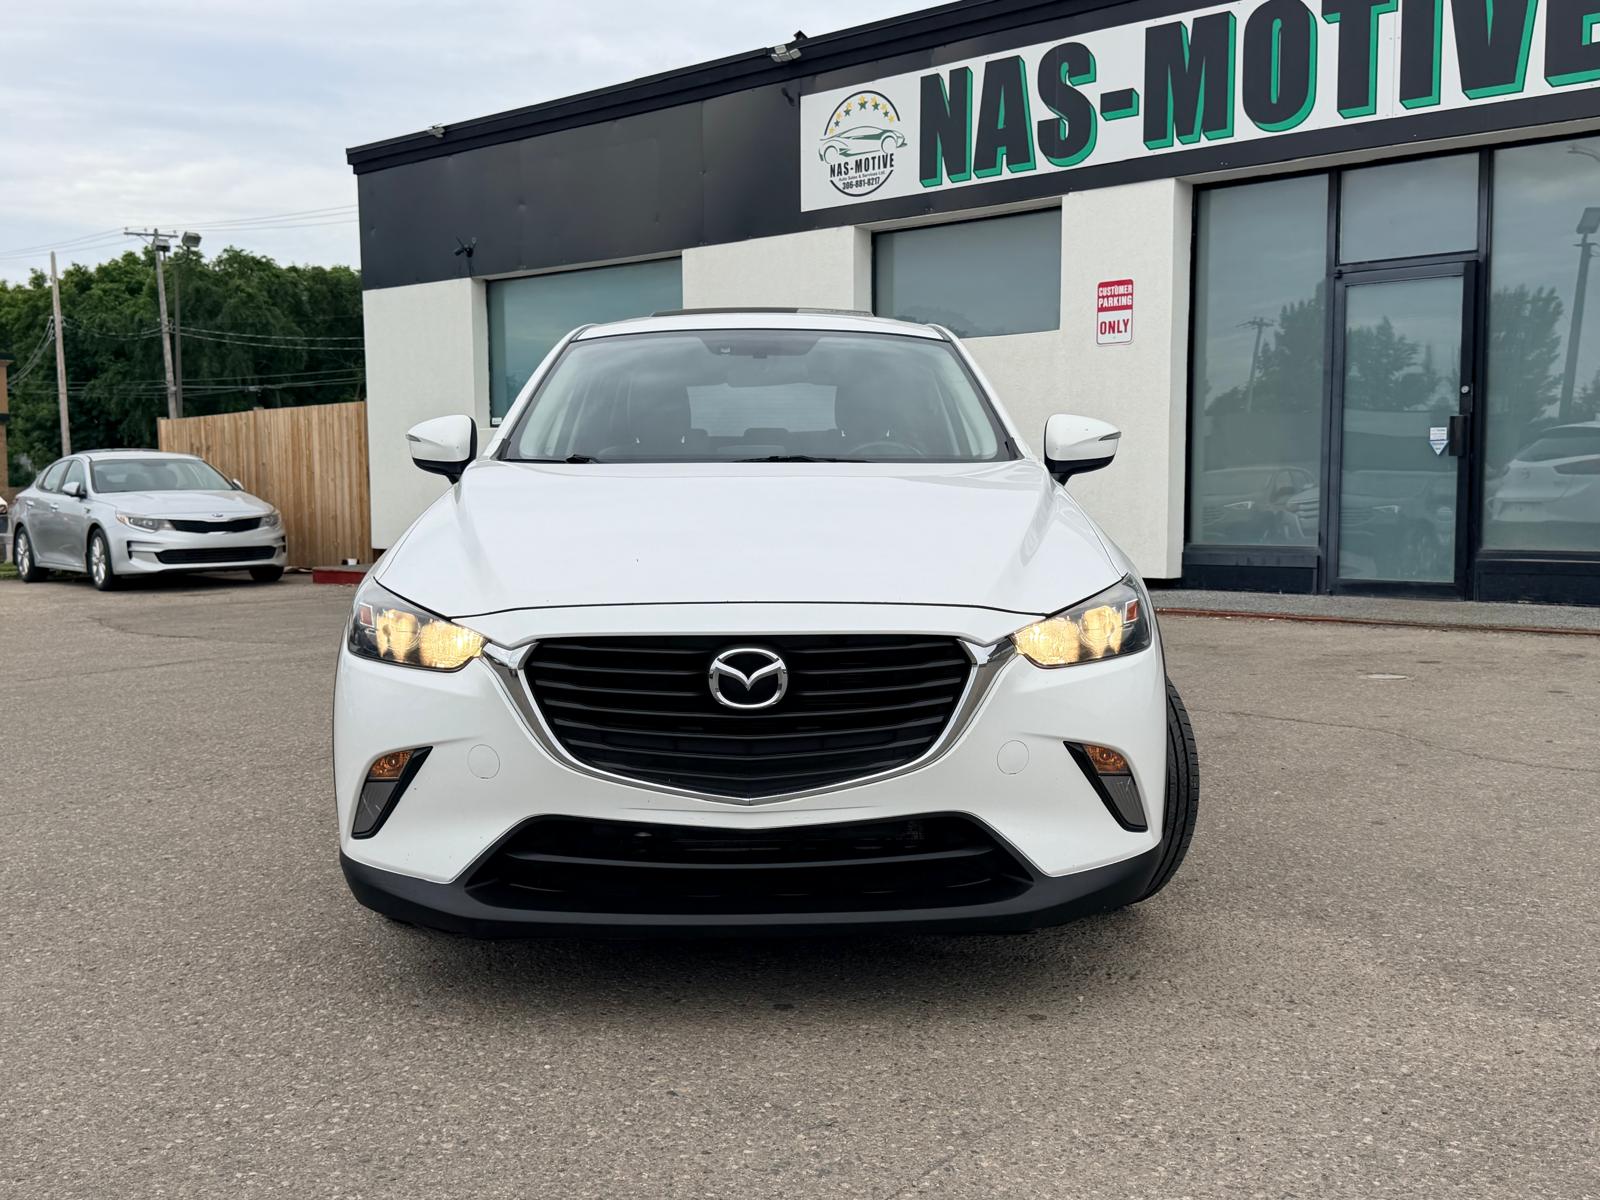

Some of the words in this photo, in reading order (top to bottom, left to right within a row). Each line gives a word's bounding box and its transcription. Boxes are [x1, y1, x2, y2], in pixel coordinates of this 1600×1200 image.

[830, 153, 894, 178] NAS-MOTIVE
[1098, 285, 1132, 296] CUSTOMER
[1098, 296, 1132, 308] PARKING
[1100, 318, 1130, 335] ONLY
